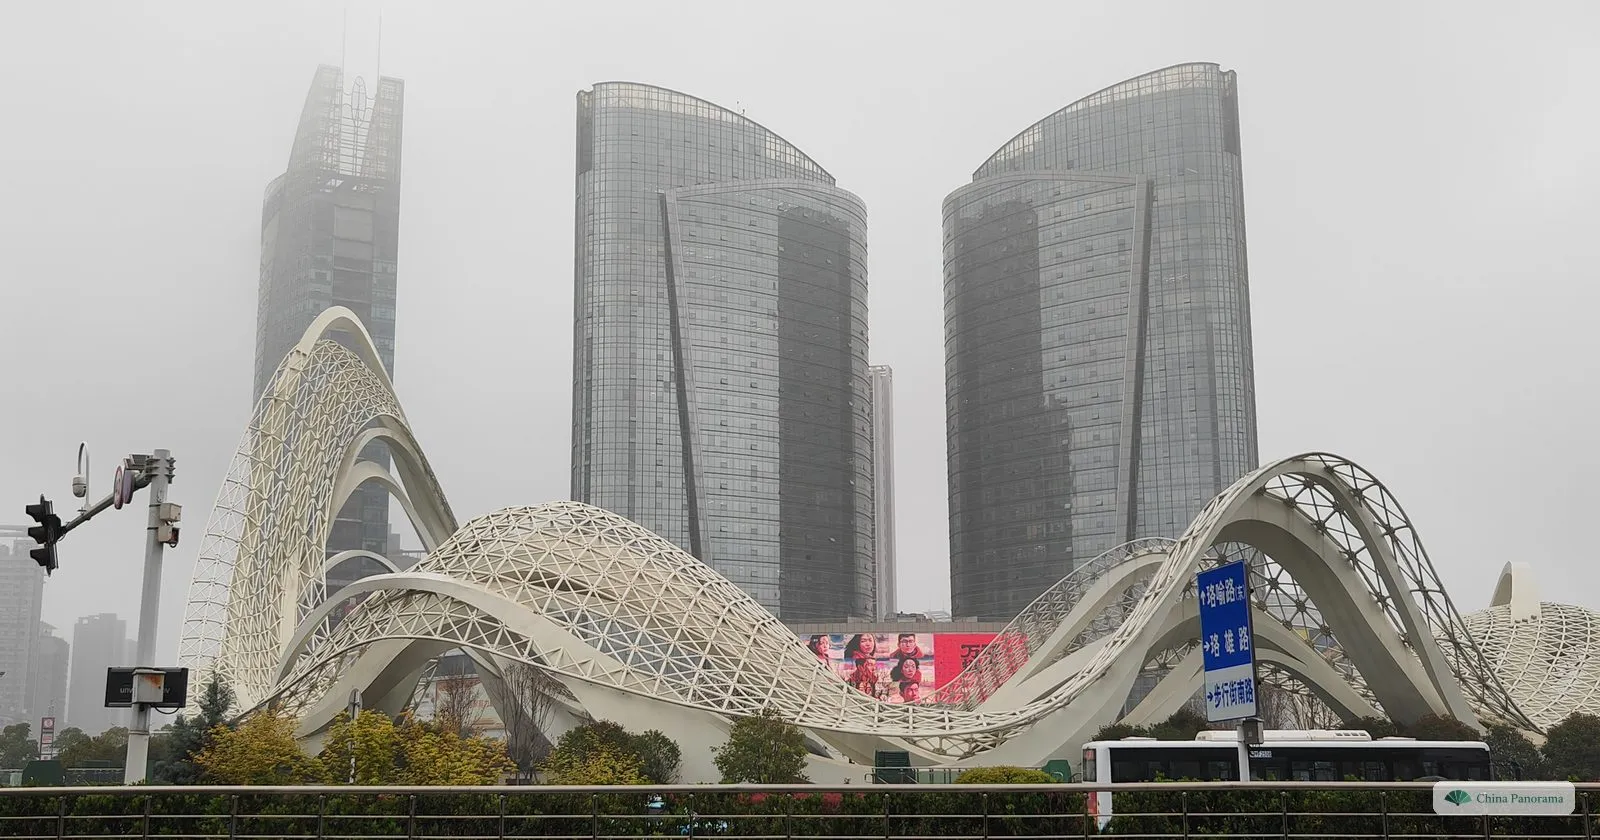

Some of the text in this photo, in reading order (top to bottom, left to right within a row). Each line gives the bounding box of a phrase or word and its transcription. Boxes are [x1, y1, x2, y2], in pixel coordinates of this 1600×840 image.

[1213, 677, 1254, 709] 步行街南路
